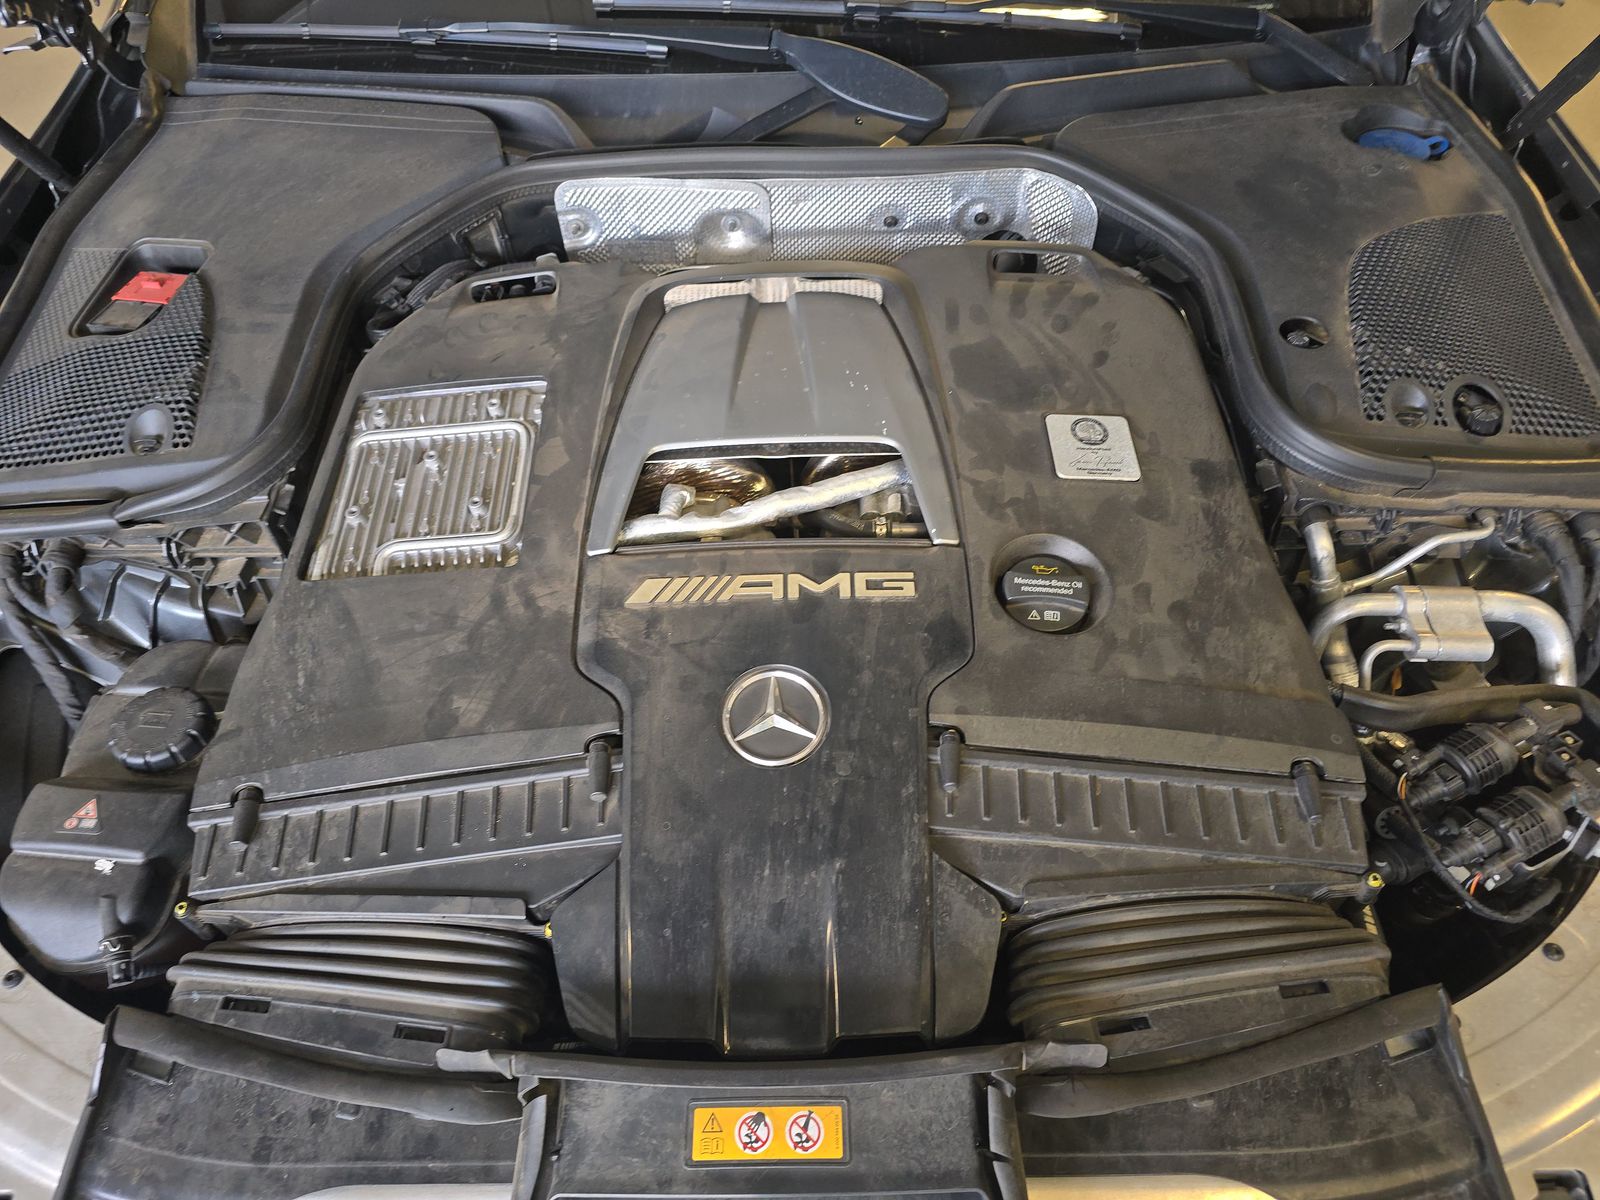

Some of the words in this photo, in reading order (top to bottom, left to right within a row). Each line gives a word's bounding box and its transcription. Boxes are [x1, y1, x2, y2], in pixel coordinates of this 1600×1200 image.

[717, 571, 916, 601] AMG
[1014, 577, 1071, 587] Mercedes-Benz
[1021, 585, 1073, 594] recommended
